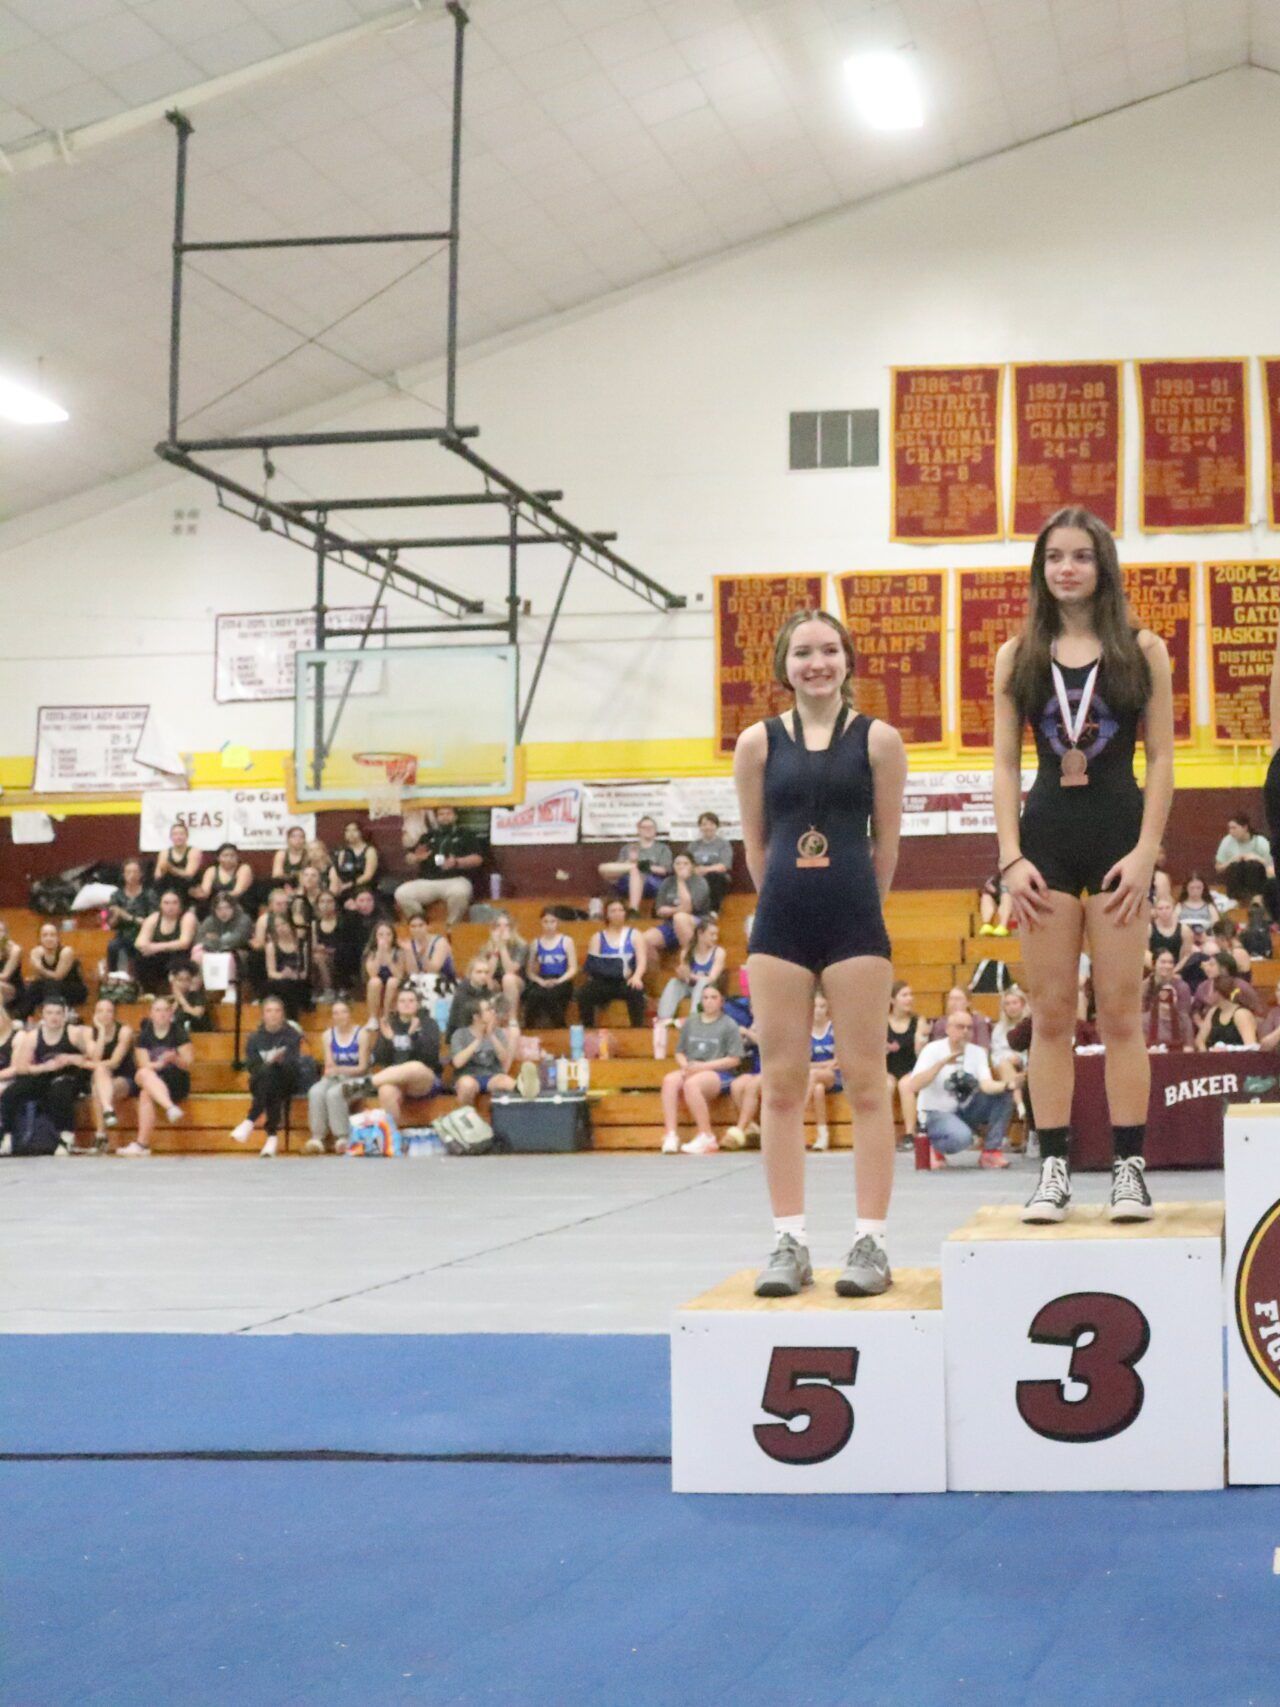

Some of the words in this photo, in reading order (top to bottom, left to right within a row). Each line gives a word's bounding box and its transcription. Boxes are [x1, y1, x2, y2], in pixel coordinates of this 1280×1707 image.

[903, 393, 990, 411] DISTRICT
[1025, 401, 1109, 420] DISTRICT
[1150, 397, 1235, 415] DISTRICT
[899, 411, 992, 428] REGIONAL
[1155, 416, 1232, 434] CHAMPS
[895, 428, 995, 447] SECTIONAL
[1030, 421, 1105, 439] CHAMPS
[904, 447, 982, 464] CHAMPS
[963, 587, 1007, 600] BAKER
[1130, 586, 1172, 603] RICT
[728, 595, 813, 613] DISTRICT
[848, 596, 935, 614] DISTRICT
[1234, 606, 1279, 624] GATO
[735, 630, 775, 647] CHA
[1211, 626, 1277, 645] BASKET
[868, 655, 911, 674] 21-6
[1228, 664, 1272, 678] CHAMP
[235, 791, 256, 803] Go
[260, 791, 286, 802] Gat
[175, 811, 224, 828] SEAS
[263, 811, 282, 820] We
[243, 827, 273, 837] Love
[1164, 1073, 1239, 1106] BAKER
[1016, 1292, 1150, 1443] 3
[753, 1346, 860, 1465] 5
